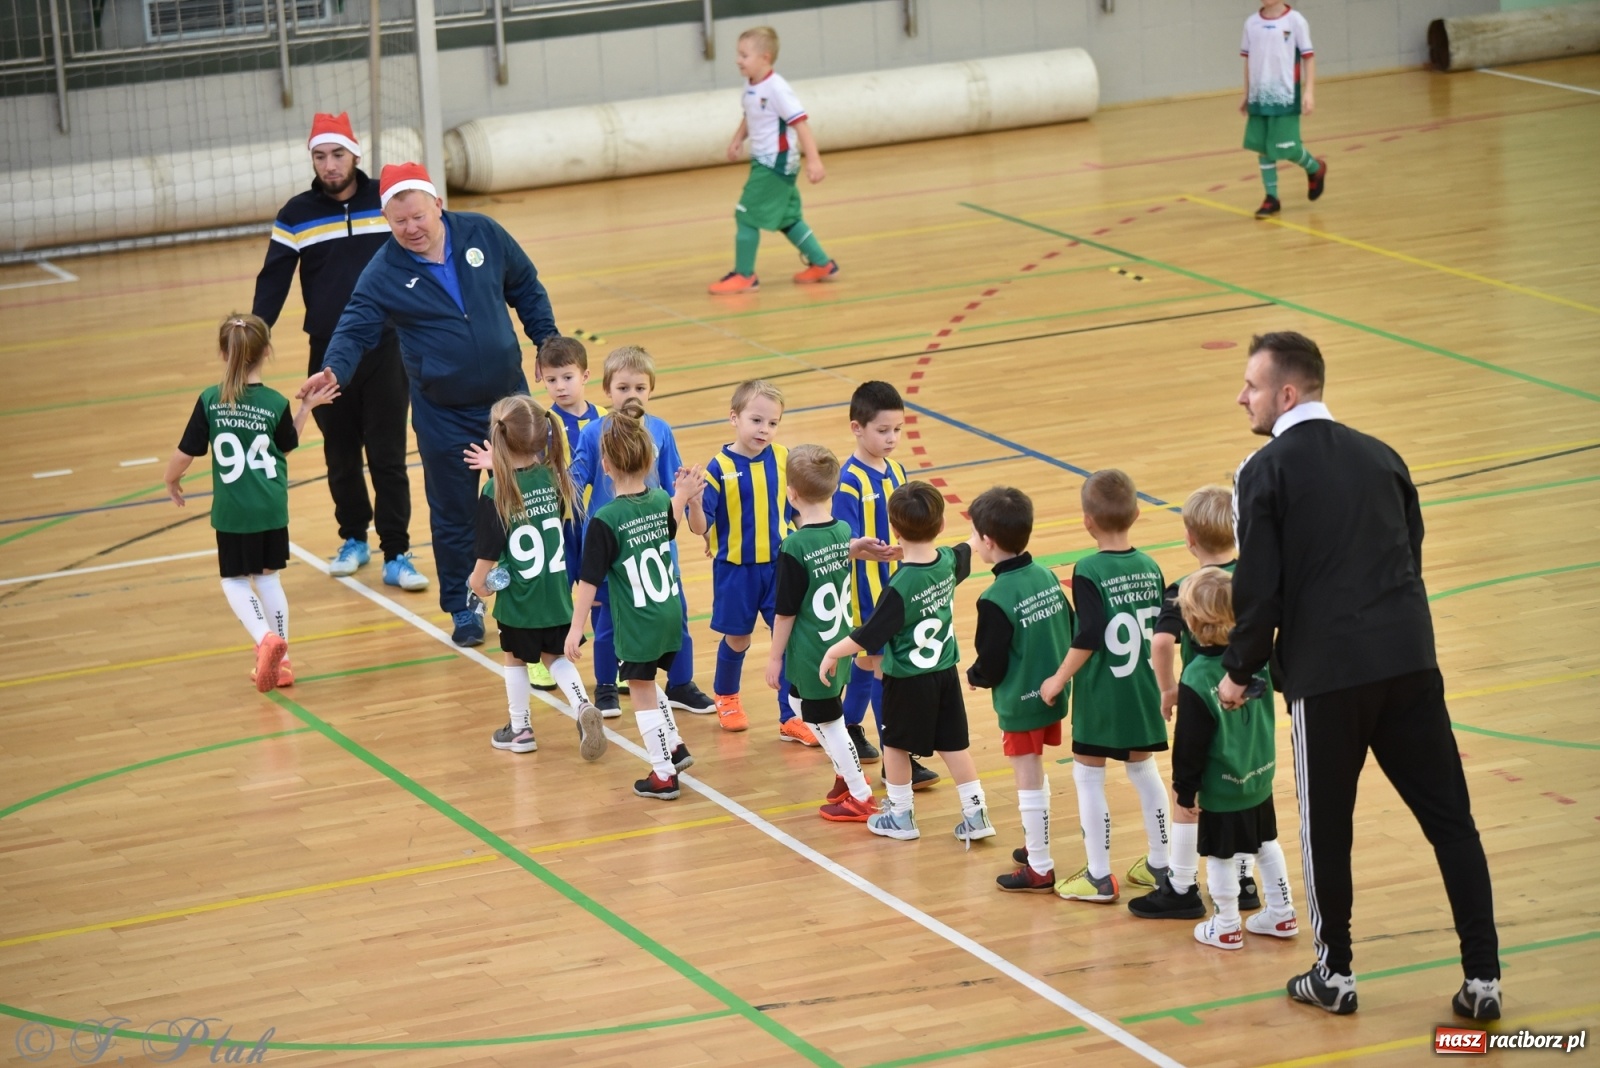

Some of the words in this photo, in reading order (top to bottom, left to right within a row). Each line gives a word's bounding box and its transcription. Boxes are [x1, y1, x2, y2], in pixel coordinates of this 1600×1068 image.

[215, 418, 268, 432] TWORKÓW
[213, 432, 277, 484] 94
[509, 517, 566, 579] 92
[1108, 587, 1160, 608] TWORKÓW
